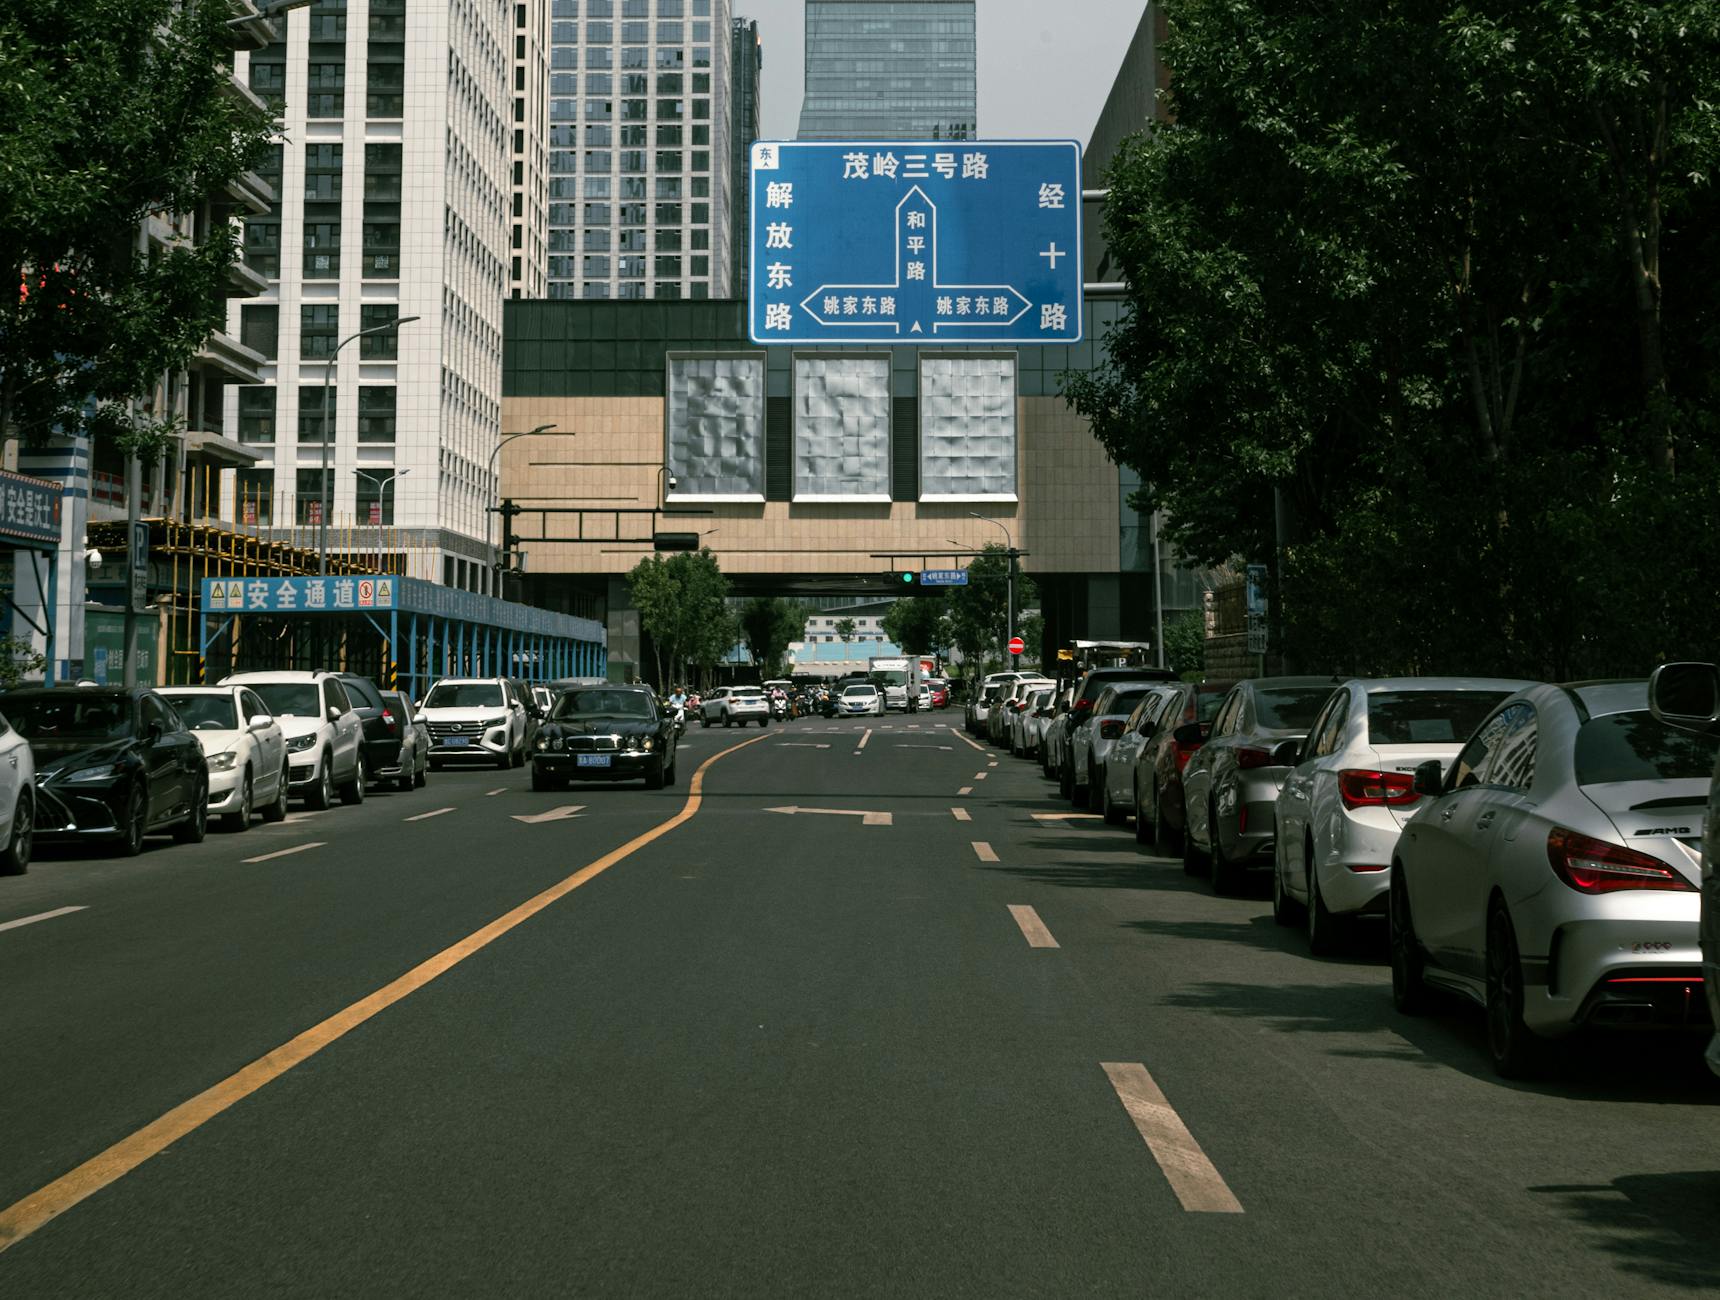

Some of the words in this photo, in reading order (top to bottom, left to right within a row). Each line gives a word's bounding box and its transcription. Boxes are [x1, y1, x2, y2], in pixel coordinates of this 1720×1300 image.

[760, 147, 772, 160] 东
[842, 152, 989, 179] 茂岭三号路
[764, 181, 793, 331] 解放东路
[906, 210, 926, 281] 和平路
[1038, 182, 1068, 331] 经十路
[823, 295, 896, 316] 姚家东路
[936, 295, 1009, 316] 姚家东路
[247, 579, 355, 609] 安全通道
[1652, 827, 1691, 835] AMG
